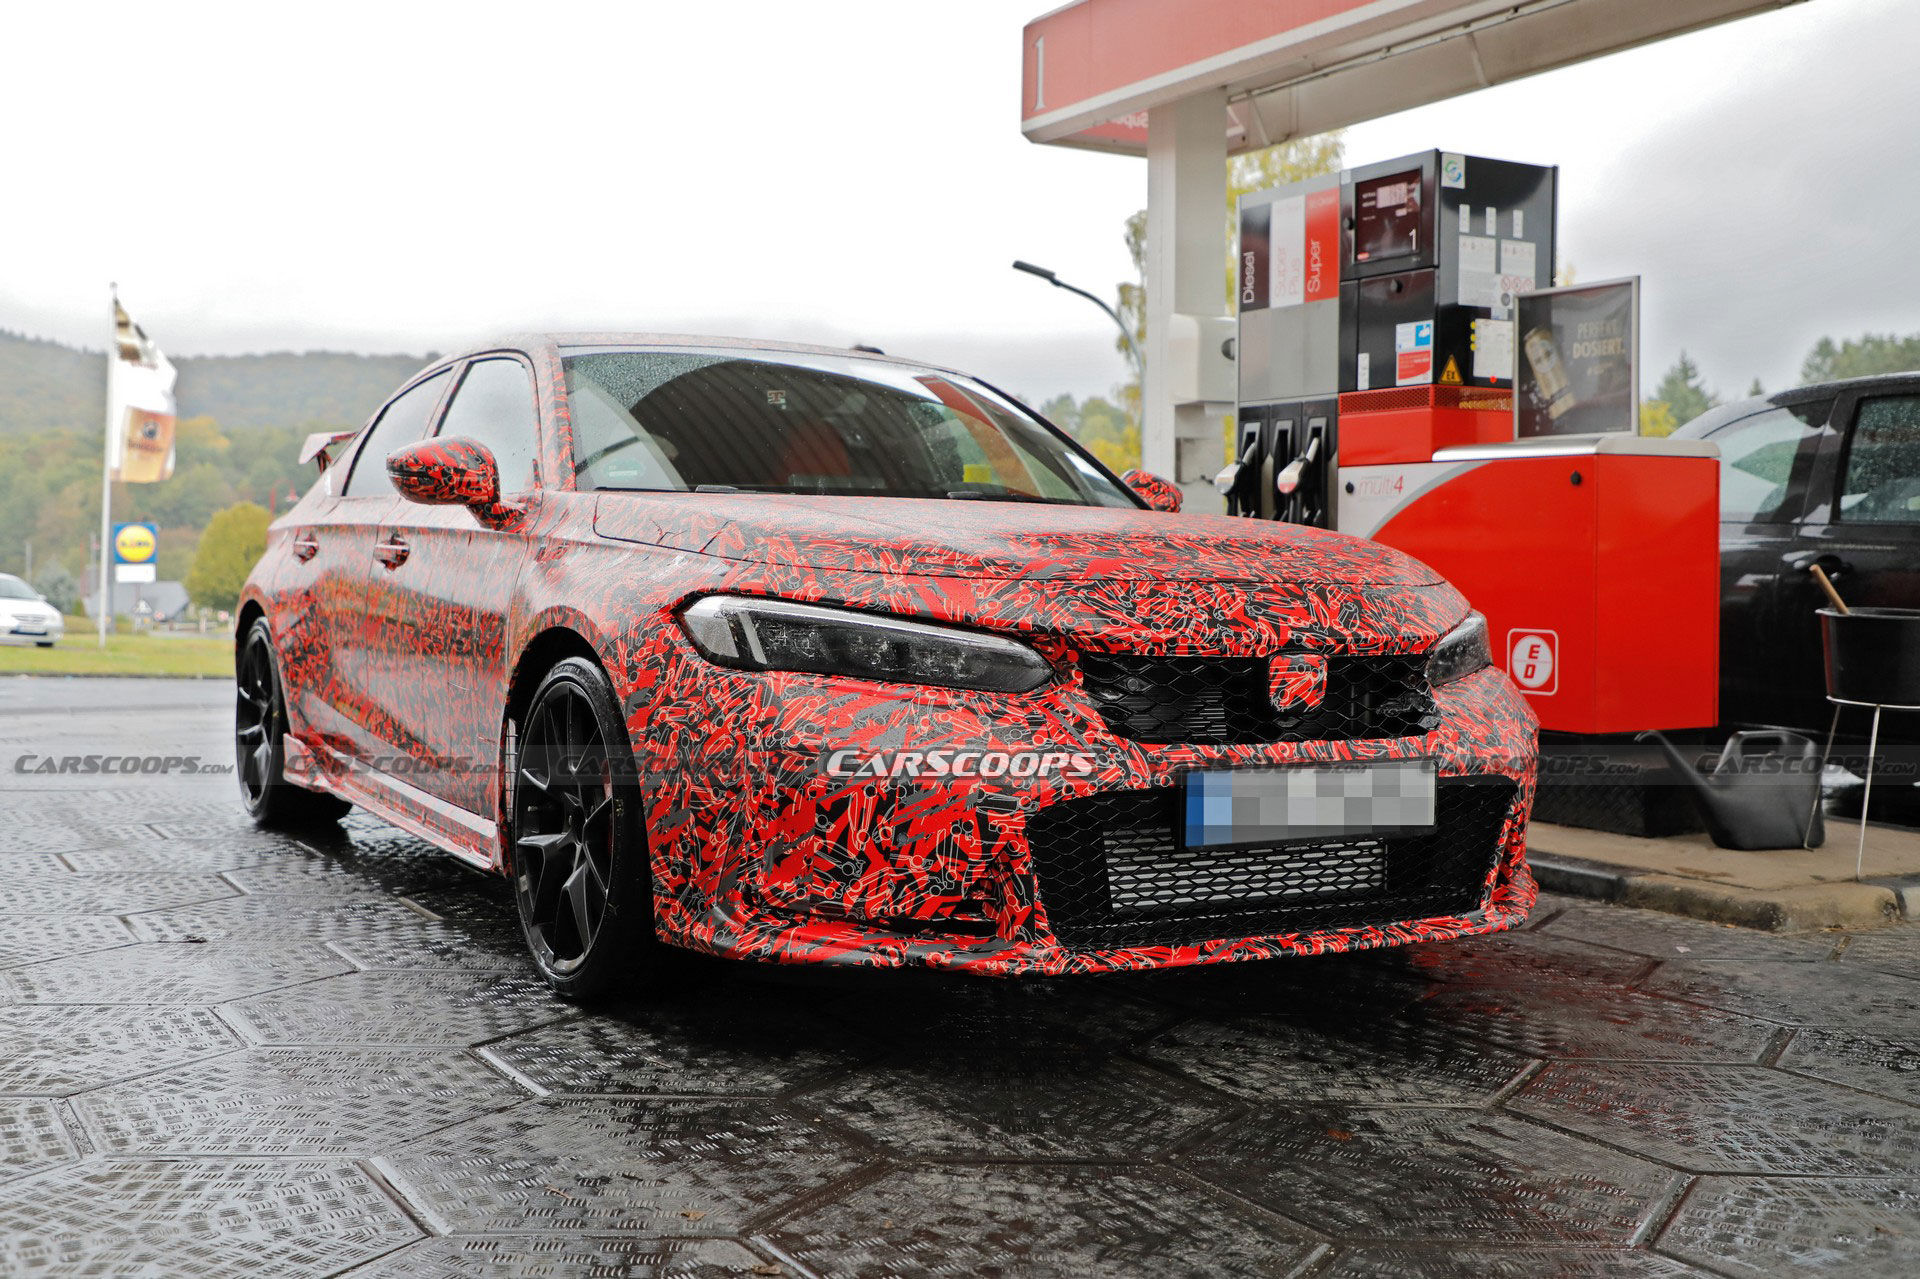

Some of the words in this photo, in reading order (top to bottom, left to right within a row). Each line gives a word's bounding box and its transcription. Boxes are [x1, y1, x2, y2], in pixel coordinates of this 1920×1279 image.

[1307, 238, 1323, 294] Super
[1409, 228, 1417, 251] 1
[1242, 251, 1255, 304] Diesel
